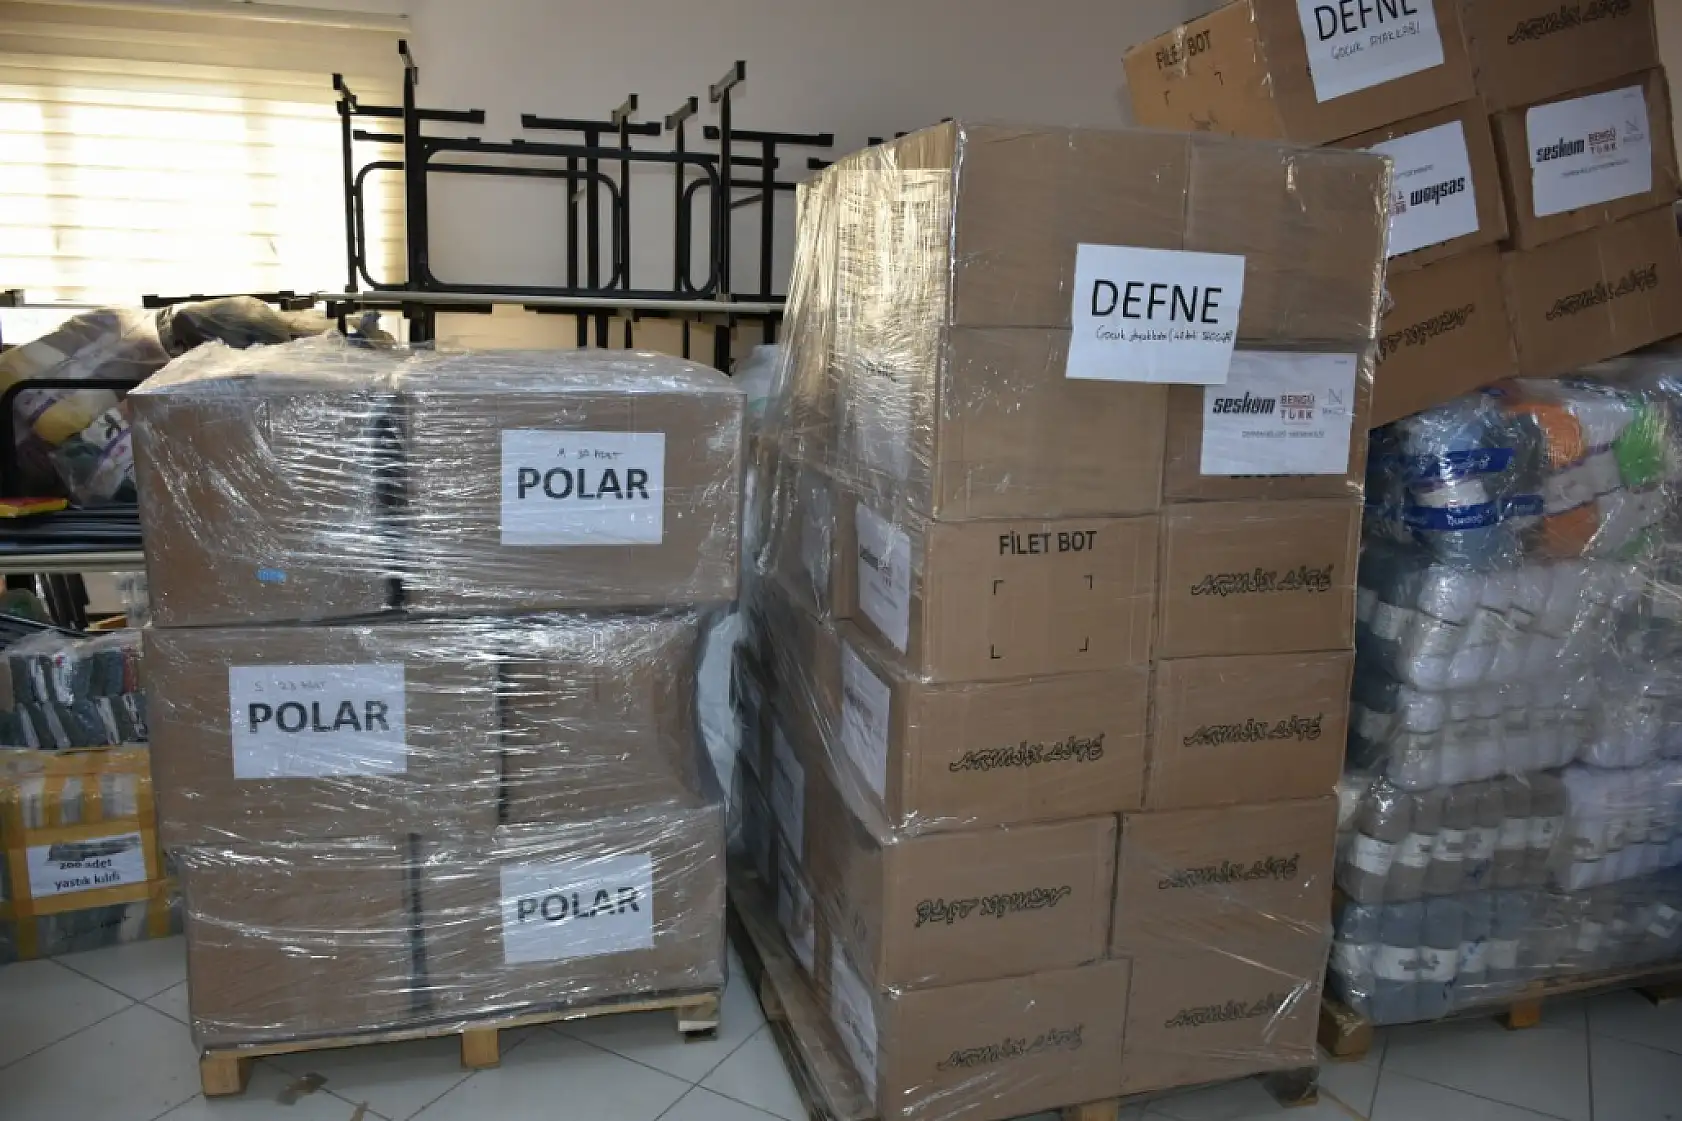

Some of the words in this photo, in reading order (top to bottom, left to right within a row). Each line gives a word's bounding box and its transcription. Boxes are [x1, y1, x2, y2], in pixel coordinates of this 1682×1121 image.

[1189, 29, 1212, 57] BOT
[1536, 137, 1585, 162] seskom
[1091, 278, 1222, 324] DEFNE
[1212, 390, 1276, 415] seskom
[517, 467, 650, 500] POLAR
[999, 531, 1051, 555] FİLET
[1057, 530, 1098, 552] BOT
[248, 700, 390, 734] POLAR
[518, 886, 640, 924] POLAR
